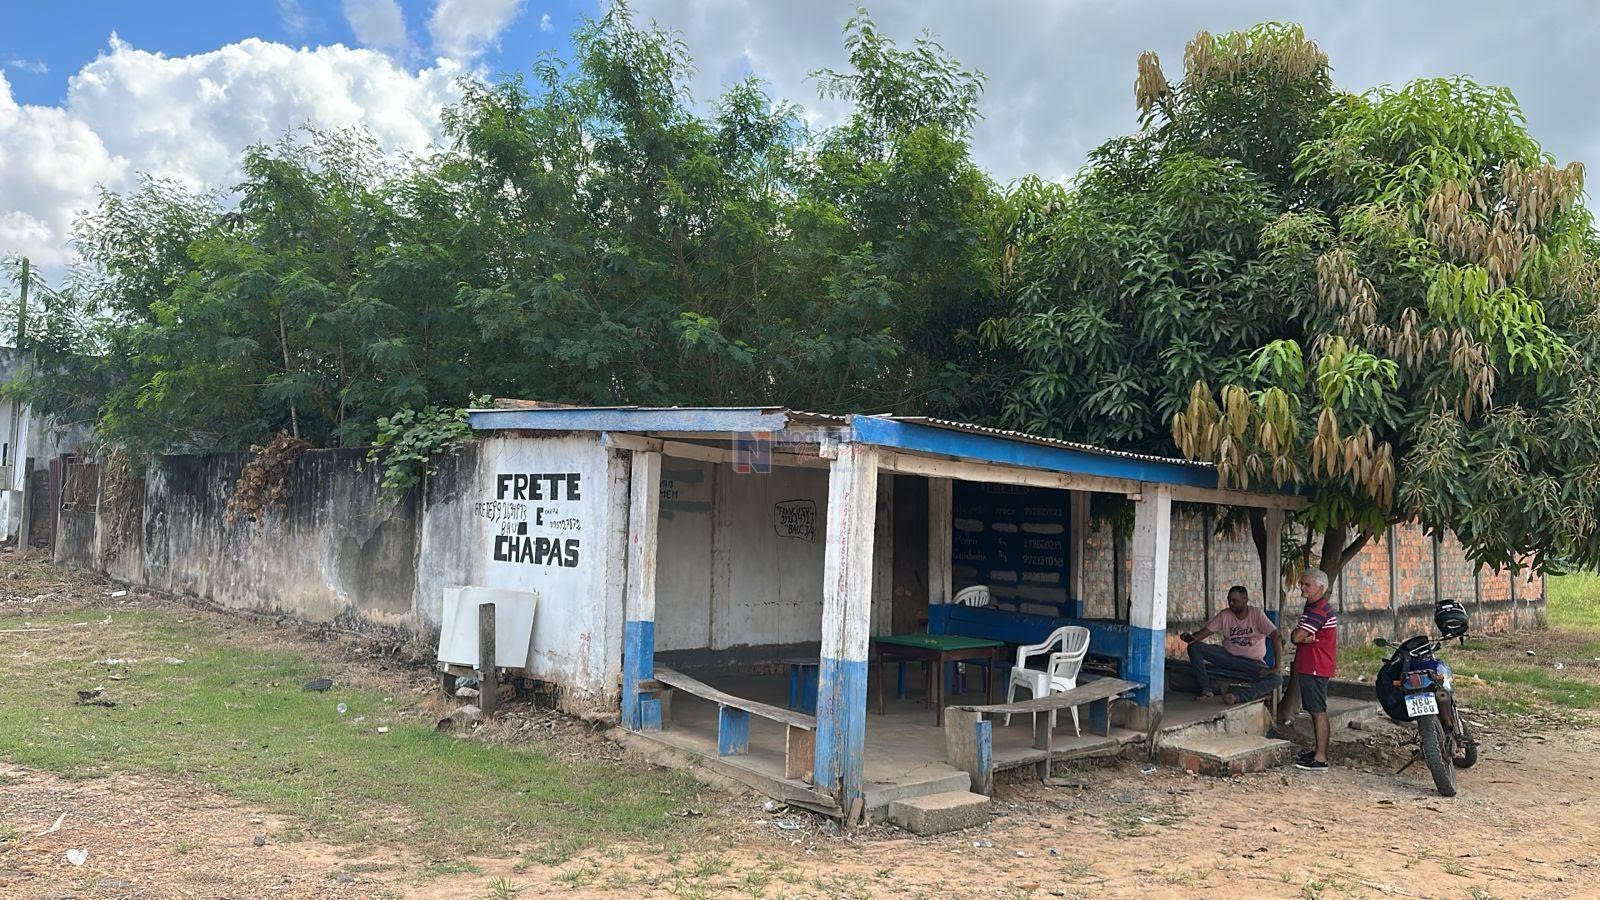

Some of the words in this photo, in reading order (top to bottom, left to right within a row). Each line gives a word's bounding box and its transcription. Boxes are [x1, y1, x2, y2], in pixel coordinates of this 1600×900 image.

[496, 473, 581, 501] FRETE
[536, 507, 543, 526] E
[493, 535, 580, 568] CHAPAS
